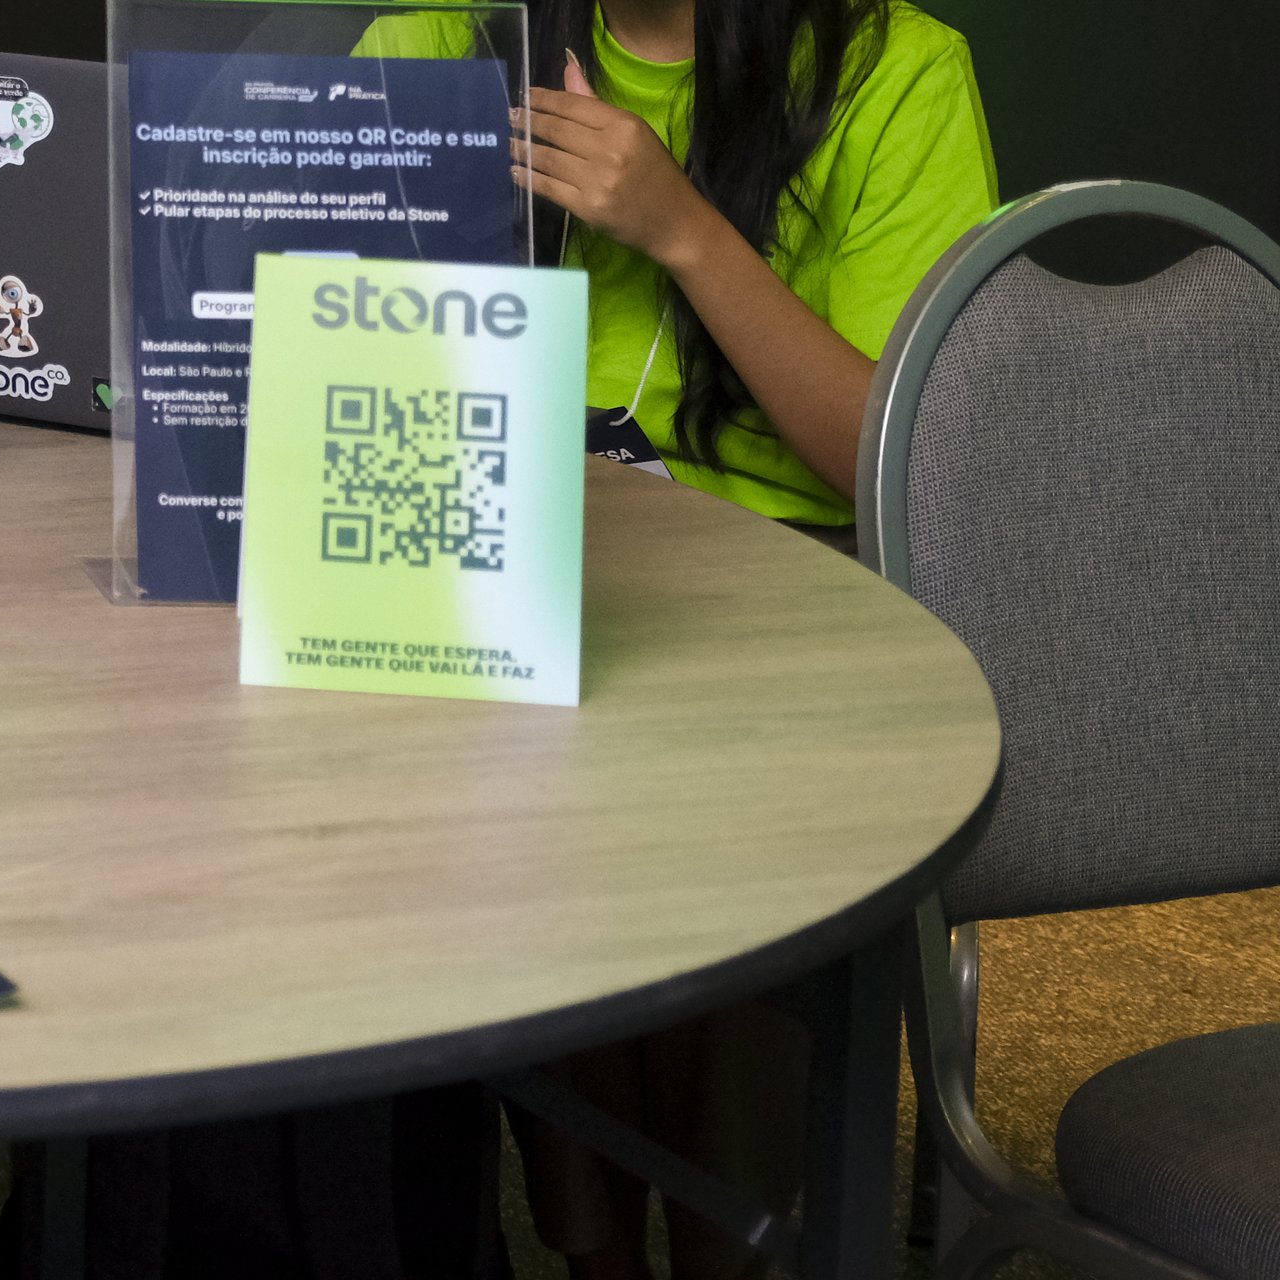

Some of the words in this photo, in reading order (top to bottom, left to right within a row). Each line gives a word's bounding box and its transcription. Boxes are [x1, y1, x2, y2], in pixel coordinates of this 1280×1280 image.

[136, 124, 257, 143] Cadastre-se
[260, 129, 290, 143] em
[295, 129, 353, 145] nosso
[357, 126, 386, 146] QR
[389, 128, 442, 146] Code
[445, 133, 458, 146] e
[462, 132, 497, 147] sua
[203, 145, 292, 167] inscrição
[295, 148, 345, 169] pode
[349, 150, 432, 170] garantir:
[153, 189, 225, 202] Prioridade
[228, 192, 245, 202] na
[247, 191, 297, 203] análise
[300, 192, 318, 204] do
[320, 195, 346, 205] seu
[348, 192, 386, 207] perfil
[153, 204, 190, 217] Pular
[193, 206, 240, 220] etapas
[243, 206, 261, 219] do
[263, 208, 328, 222] processo
[331, 208, 385, 221] seletivo
[387, 208, 405, 221] da
[407, 209, 449, 222] Stone
[312, 276, 528, 339] stone
[142, 342, 211, 353] Modalidade:
[142, 366, 176, 376] Local:
[179, 366, 200, 377] São
[202, 366, 233, 377] Paulo
[235, 369, 243, 377] e
[142, 389, 229, 403] Especificações
[163, 404, 217, 415] Formação
[164, 416, 188, 426] Sem
[191, 416, 238, 428] restrição
[159, 494, 217, 507] Converse
[216, 510, 225, 520] e
[300, 637, 337, 651] TEM
[341, 639, 400, 655] GENTE
[404, 643, 440, 659] QUE
[444, 646, 517, 663] ESPERA.
[286, 652, 322, 665] TEM
[326, 654, 385, 670] GENTE
[389, 658, 425, 673] QUE
[429, 660, 458, 674] VAI
[488, 665, 498, 677] E
[502, 666, 536, 681] FAZ
